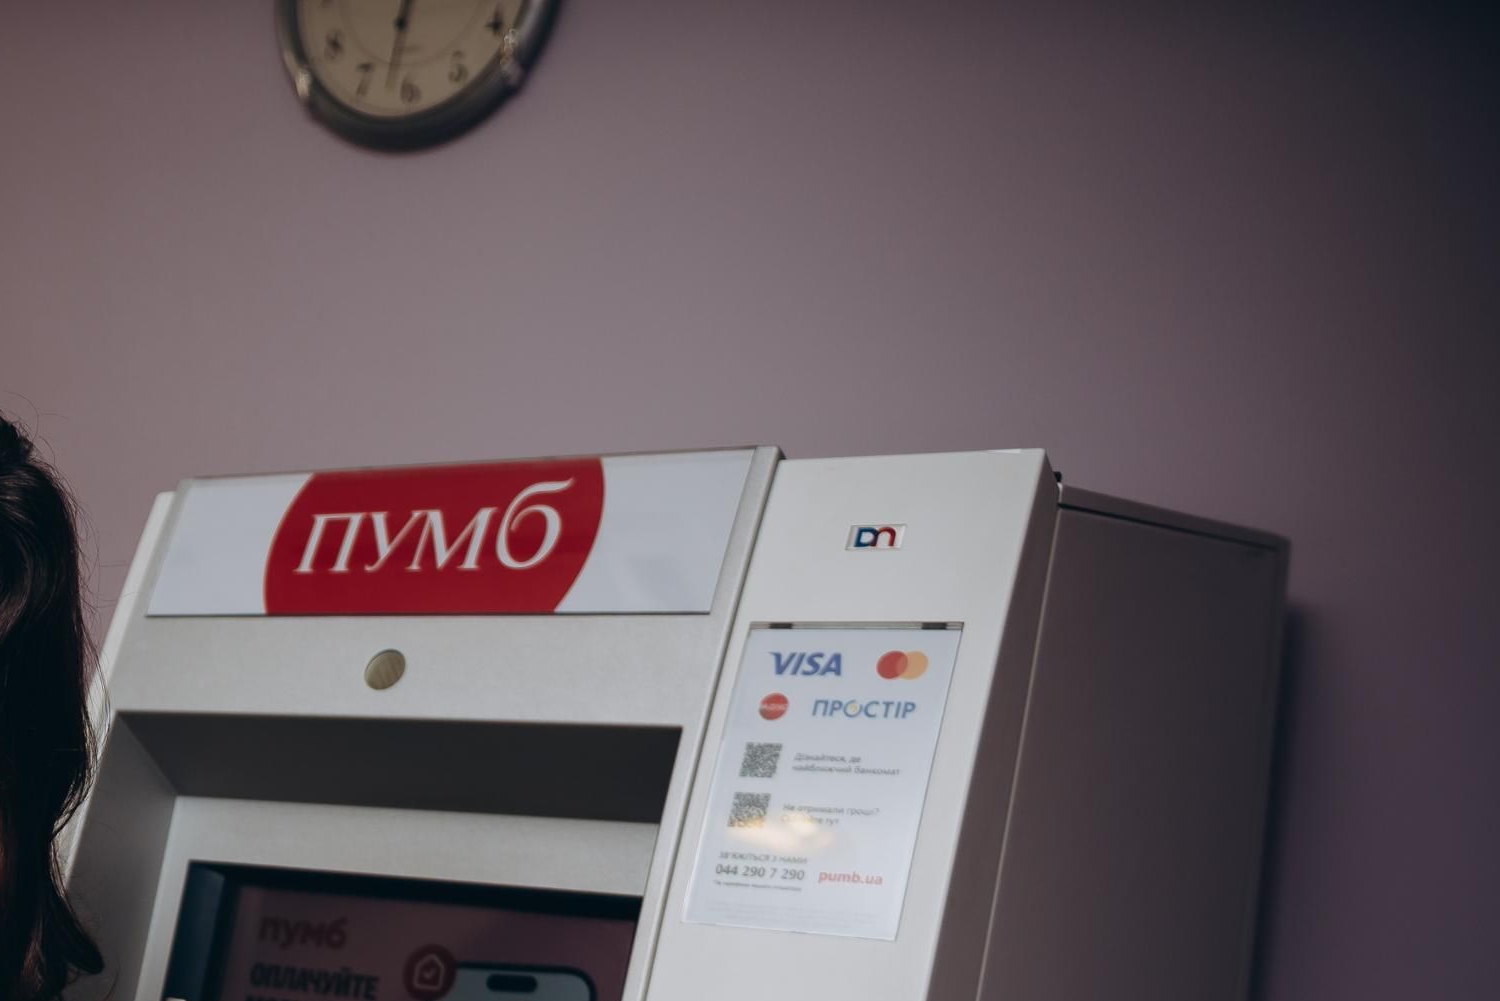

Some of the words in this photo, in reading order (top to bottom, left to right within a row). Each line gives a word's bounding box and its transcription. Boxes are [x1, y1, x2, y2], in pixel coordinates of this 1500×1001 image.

[769, 651, 842, 676] VISA
[812, 699, 916, 719] ПРОСТІР
[715, 864, 738, 875] 044
[742, 865, 766, 878] 290
[770, 867, 777, 878] 7
[781, 868, 805, 881] 290
[818, 870, 884, 885] pumb.ua
[250, 961, 380, 1001] ОПЛАЧУЙТЕ
